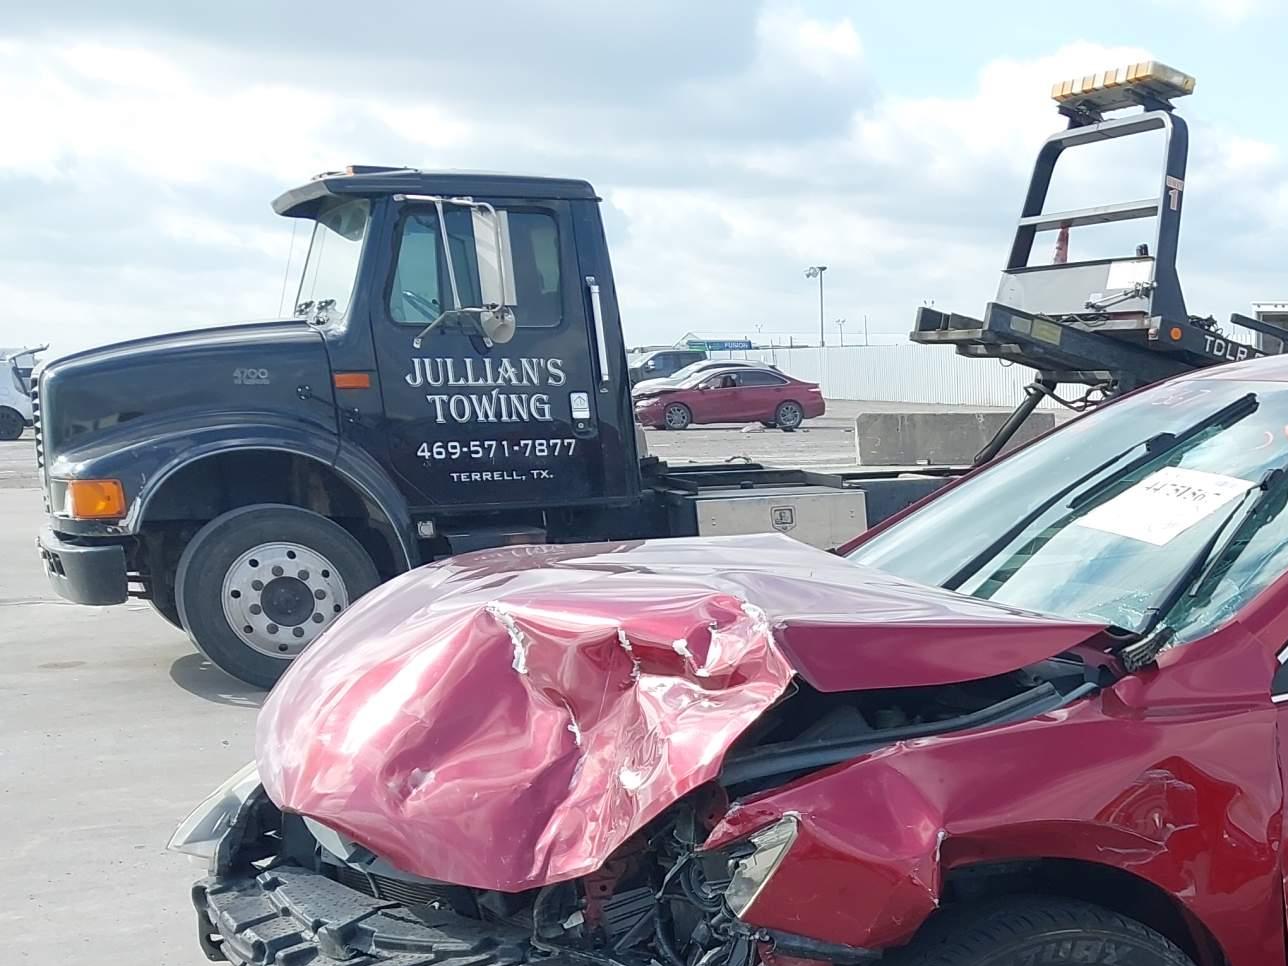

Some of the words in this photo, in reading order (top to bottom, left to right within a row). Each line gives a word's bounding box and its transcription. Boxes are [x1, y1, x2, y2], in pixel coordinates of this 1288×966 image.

[1204, 334, 1248, 361] TDLR
[405, 358, 567, 387] JULLIAN'S
[426, 389, 553, 424] TOWING
[416, 438, 577, 460] 469-571-7877
[450, 471, 526, 482] TERRELL,
[531, 469, 554, 480] TX.
